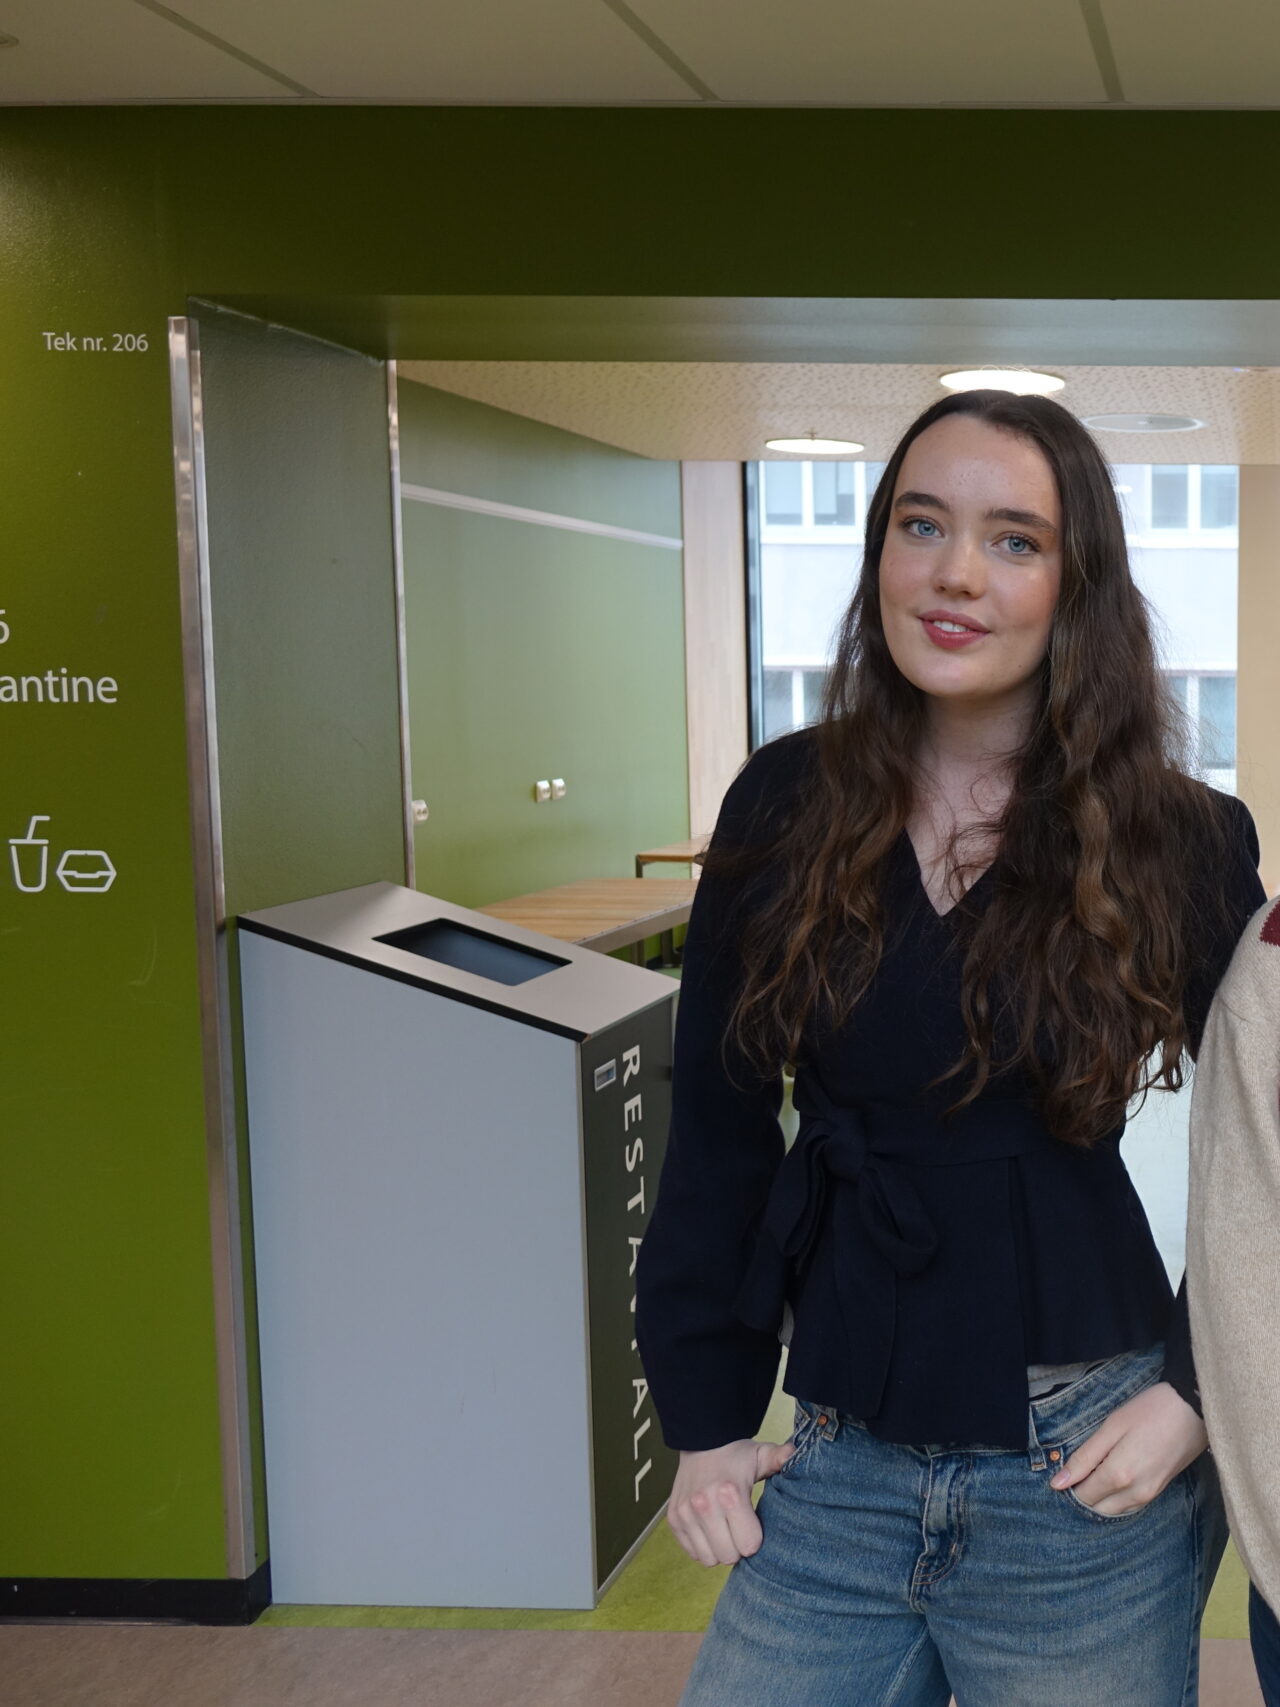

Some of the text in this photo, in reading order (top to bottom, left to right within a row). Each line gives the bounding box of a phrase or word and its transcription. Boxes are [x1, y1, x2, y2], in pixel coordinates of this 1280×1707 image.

[42, 332, 149, 352] Tek nr. 206
[622, 1044, 653, 1503] RESTAALL
